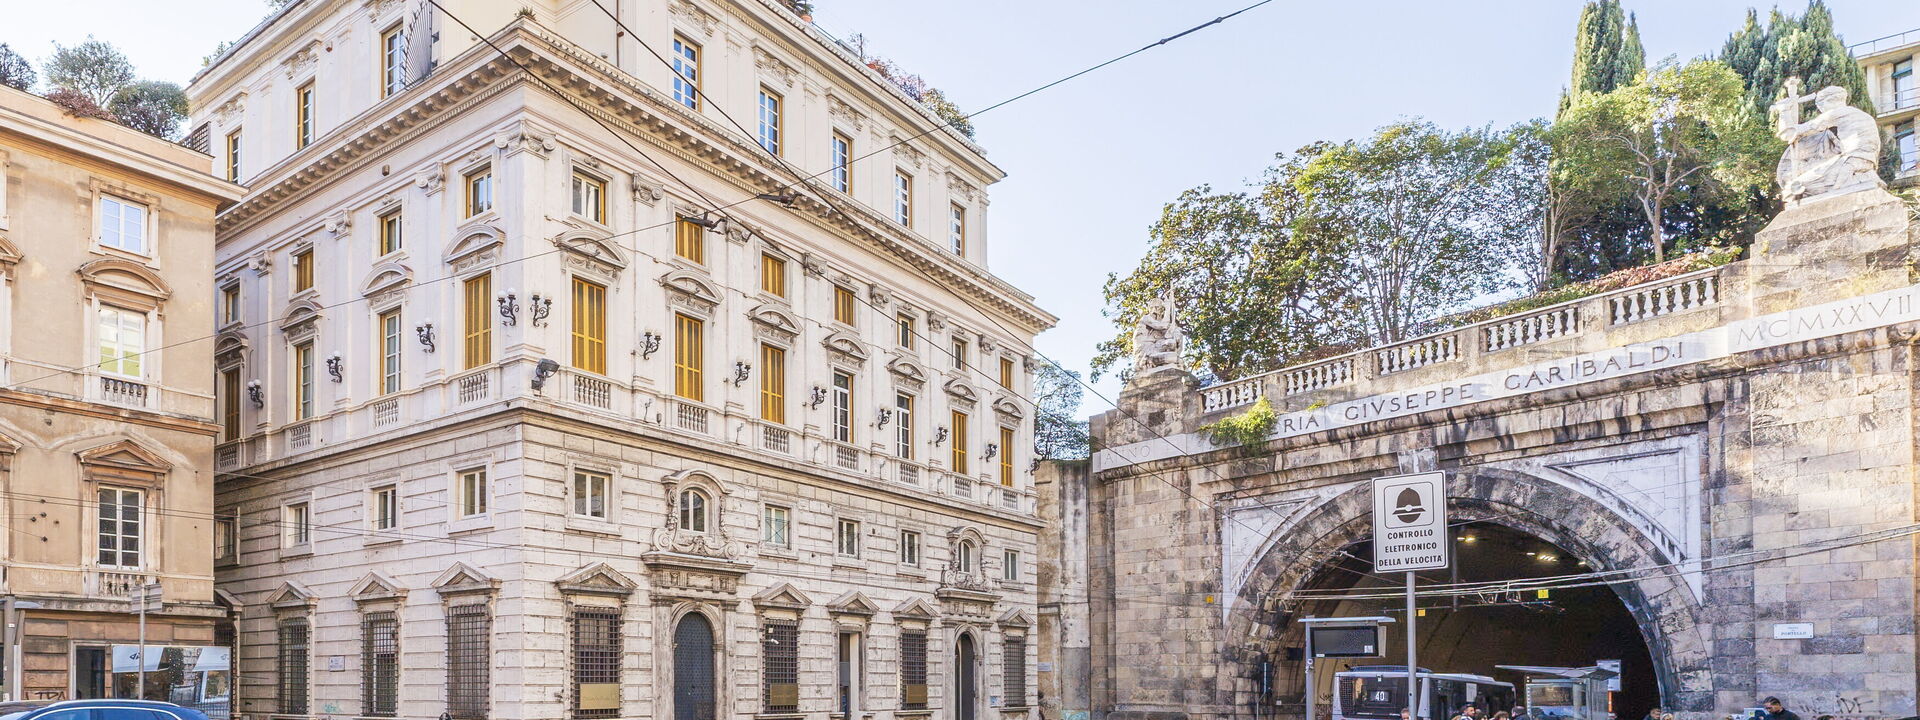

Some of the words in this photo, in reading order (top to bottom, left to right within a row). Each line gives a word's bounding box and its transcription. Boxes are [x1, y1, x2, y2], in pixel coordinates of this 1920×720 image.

[1344, 383, 1474, 420] GIVSEPPE
[1504, 341, 1683, 390] GARIBALDI
[1737, 294, 1911, 345] MCMXXVII
[1387, 529, 1433, 540] CONTROLLO
[1384, 542, 1437, 553] ELETTRONICO
[1378, 558, 1401, 567] DELLA
[1375, 691, 1385, 701] 40
